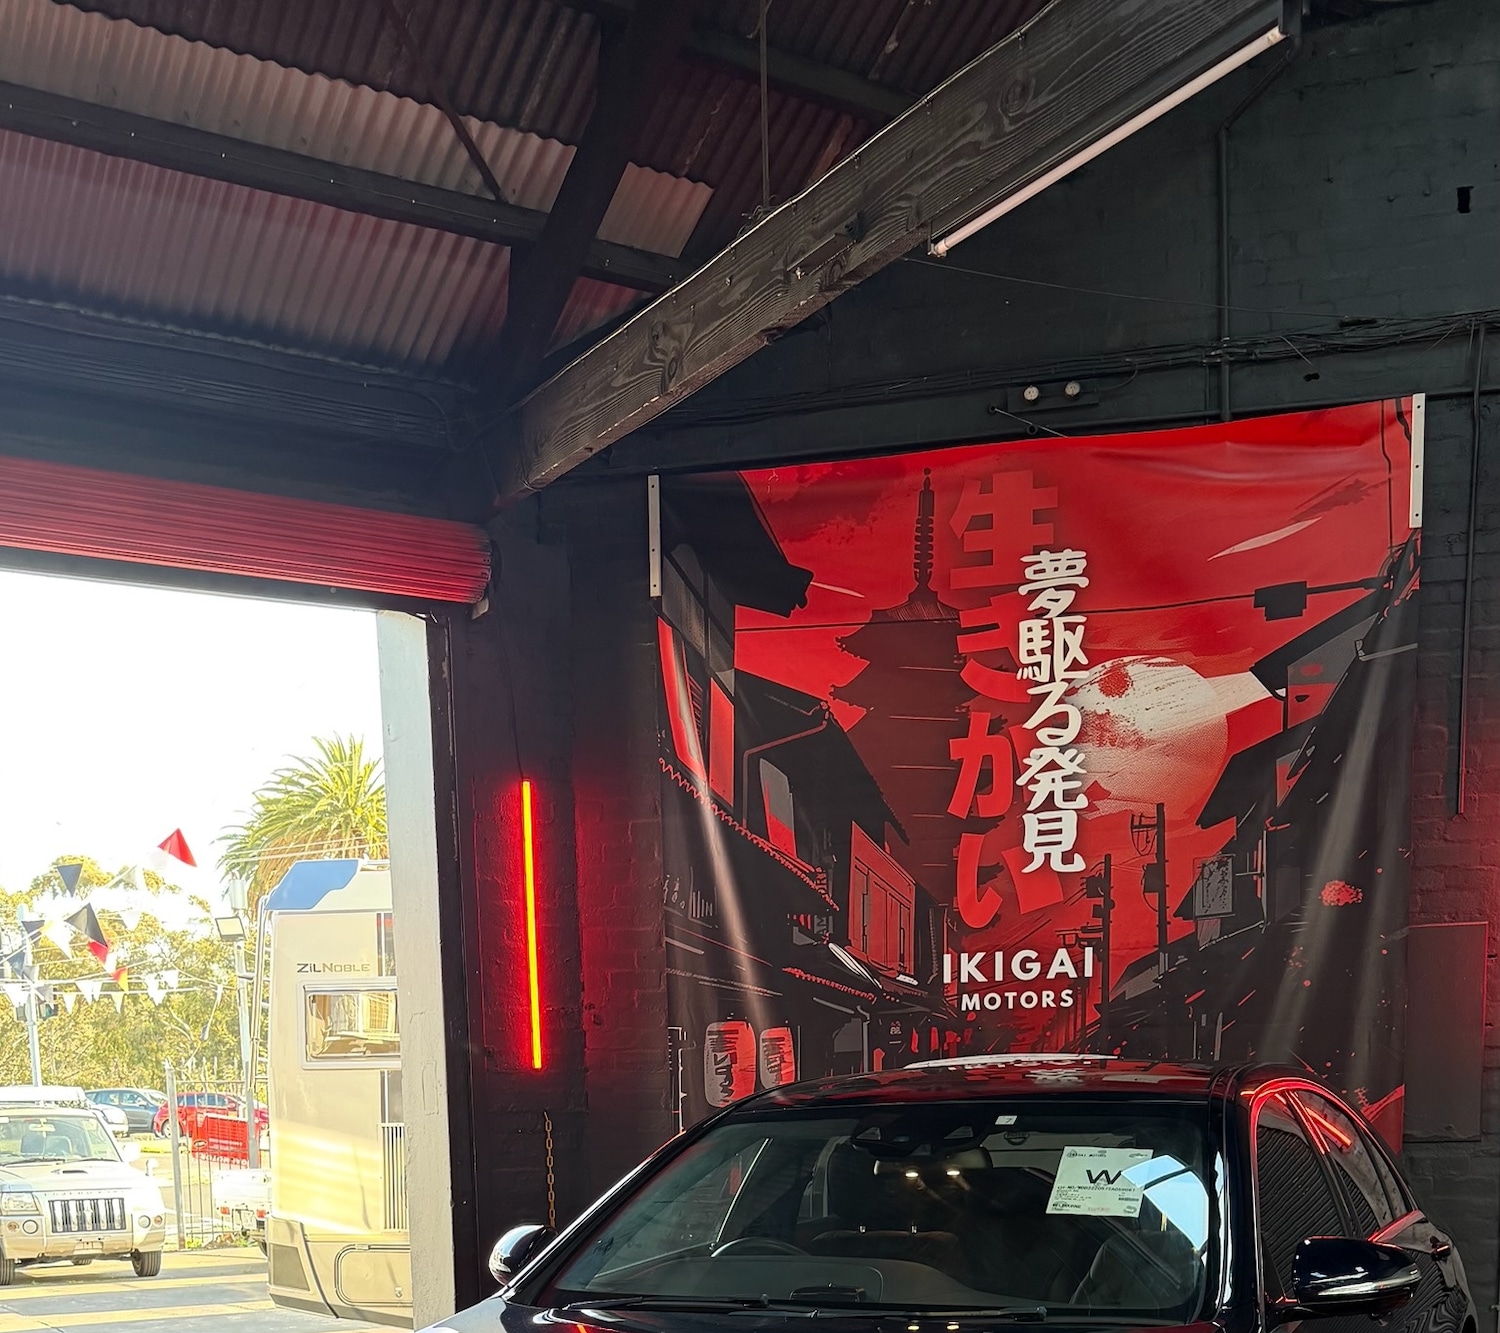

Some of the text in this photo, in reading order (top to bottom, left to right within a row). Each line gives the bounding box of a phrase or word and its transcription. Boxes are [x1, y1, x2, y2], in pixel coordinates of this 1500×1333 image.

[1016, 548, 1090, 874] 夢駆る発見
[943, 946, 1094, 984] IKIGAI
[961, 989, 1074, 1011] MOTORS
[1086, 1169, 1123, 1185] W
